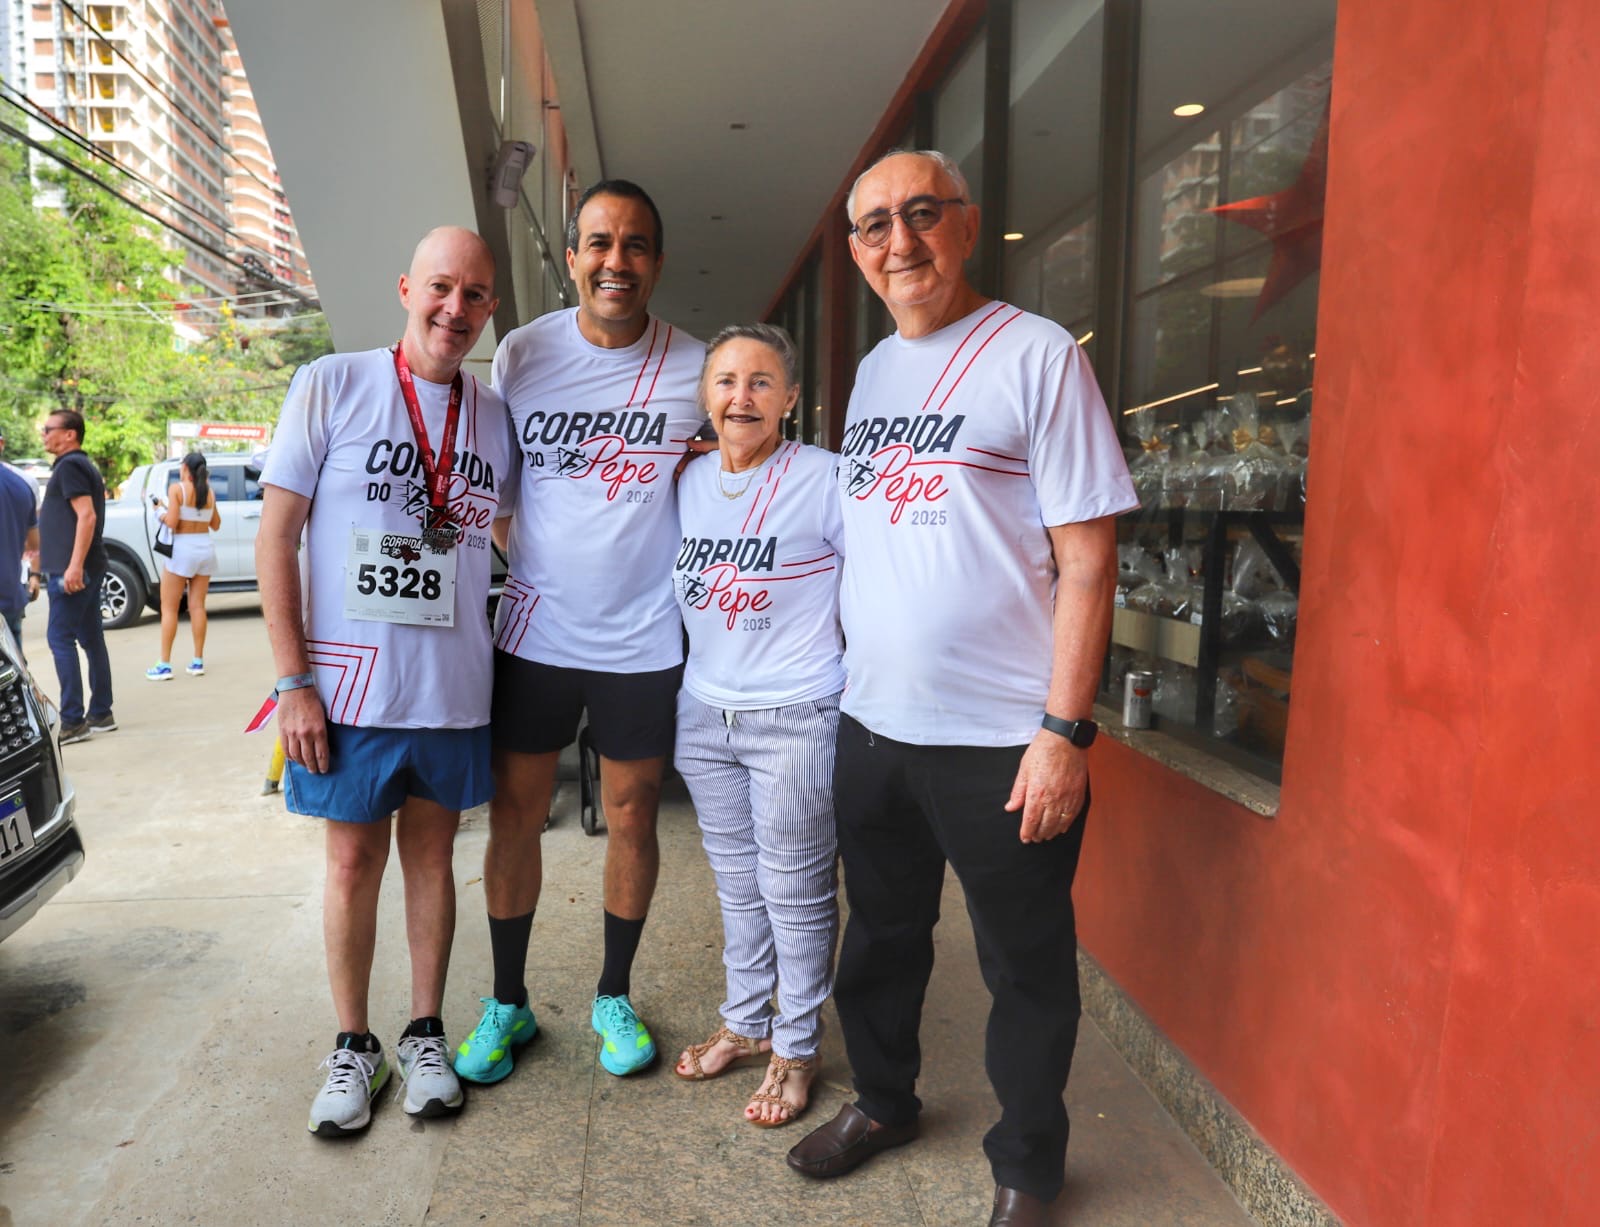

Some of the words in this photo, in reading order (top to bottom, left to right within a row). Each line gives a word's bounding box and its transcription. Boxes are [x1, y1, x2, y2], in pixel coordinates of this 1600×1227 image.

[523, 411, 668, 446] CORRIDA
[569, 435, 659, 501] Pepe
[367, 482, 391, 501] DO
[856, 444, 949, 524] Pepe
[911, 510, 947, 526] 2025
[382, 535, 422, 551] CORRIDA
[467, 534, 486, 550] 2025
[357, 563, 442, 601] 5328
[696, 563, 773, 631] Pepe
[743, 617, 771, 631] 2025
